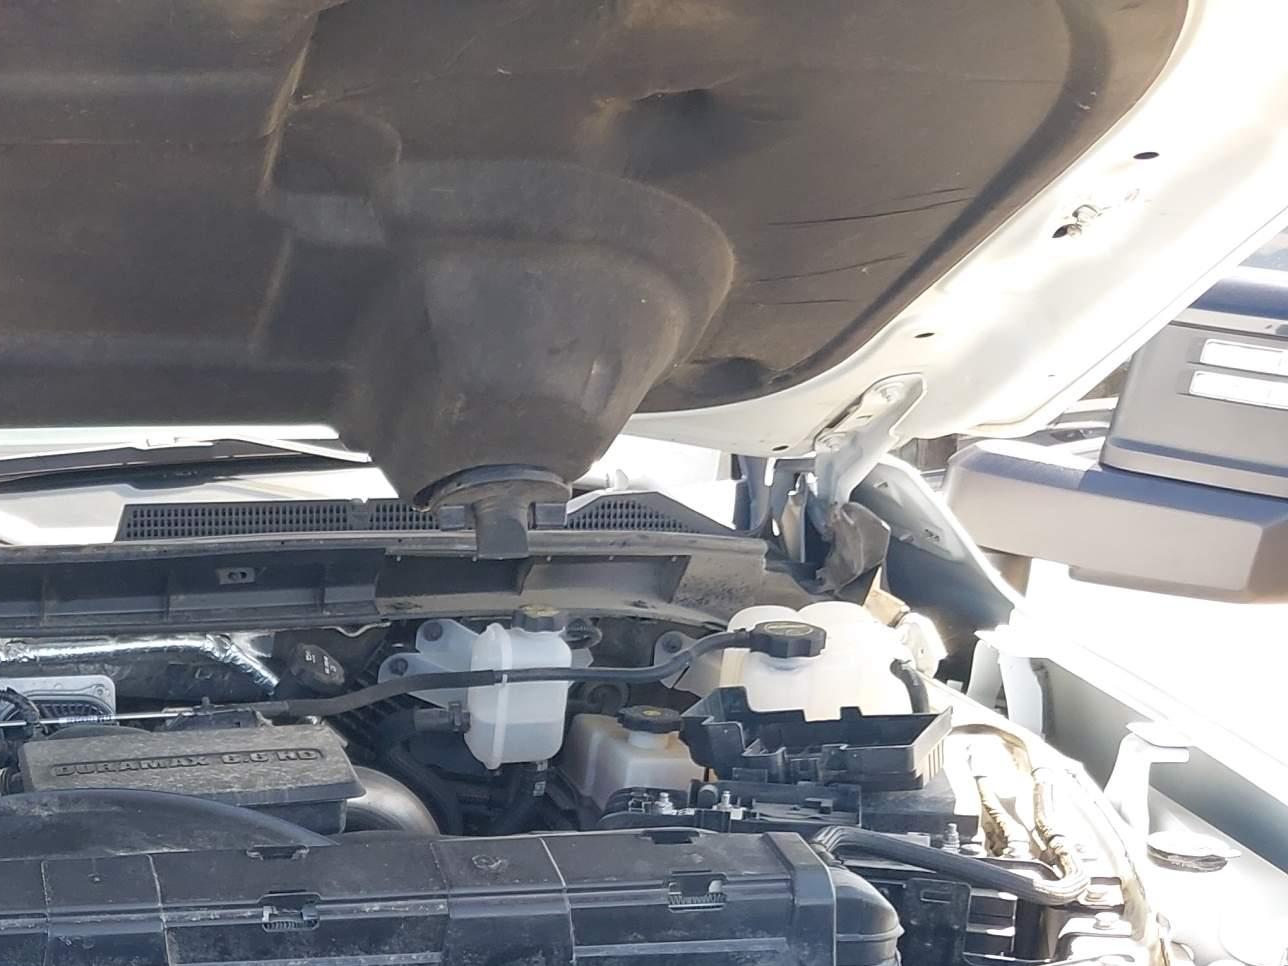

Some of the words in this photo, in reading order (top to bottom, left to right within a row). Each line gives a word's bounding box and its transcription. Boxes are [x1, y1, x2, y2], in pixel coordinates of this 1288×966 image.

[53, 755, 210, 777] DURAMAX
[221, 751, 270, 765] 6.6
[275, 749, 319, 761] HD
